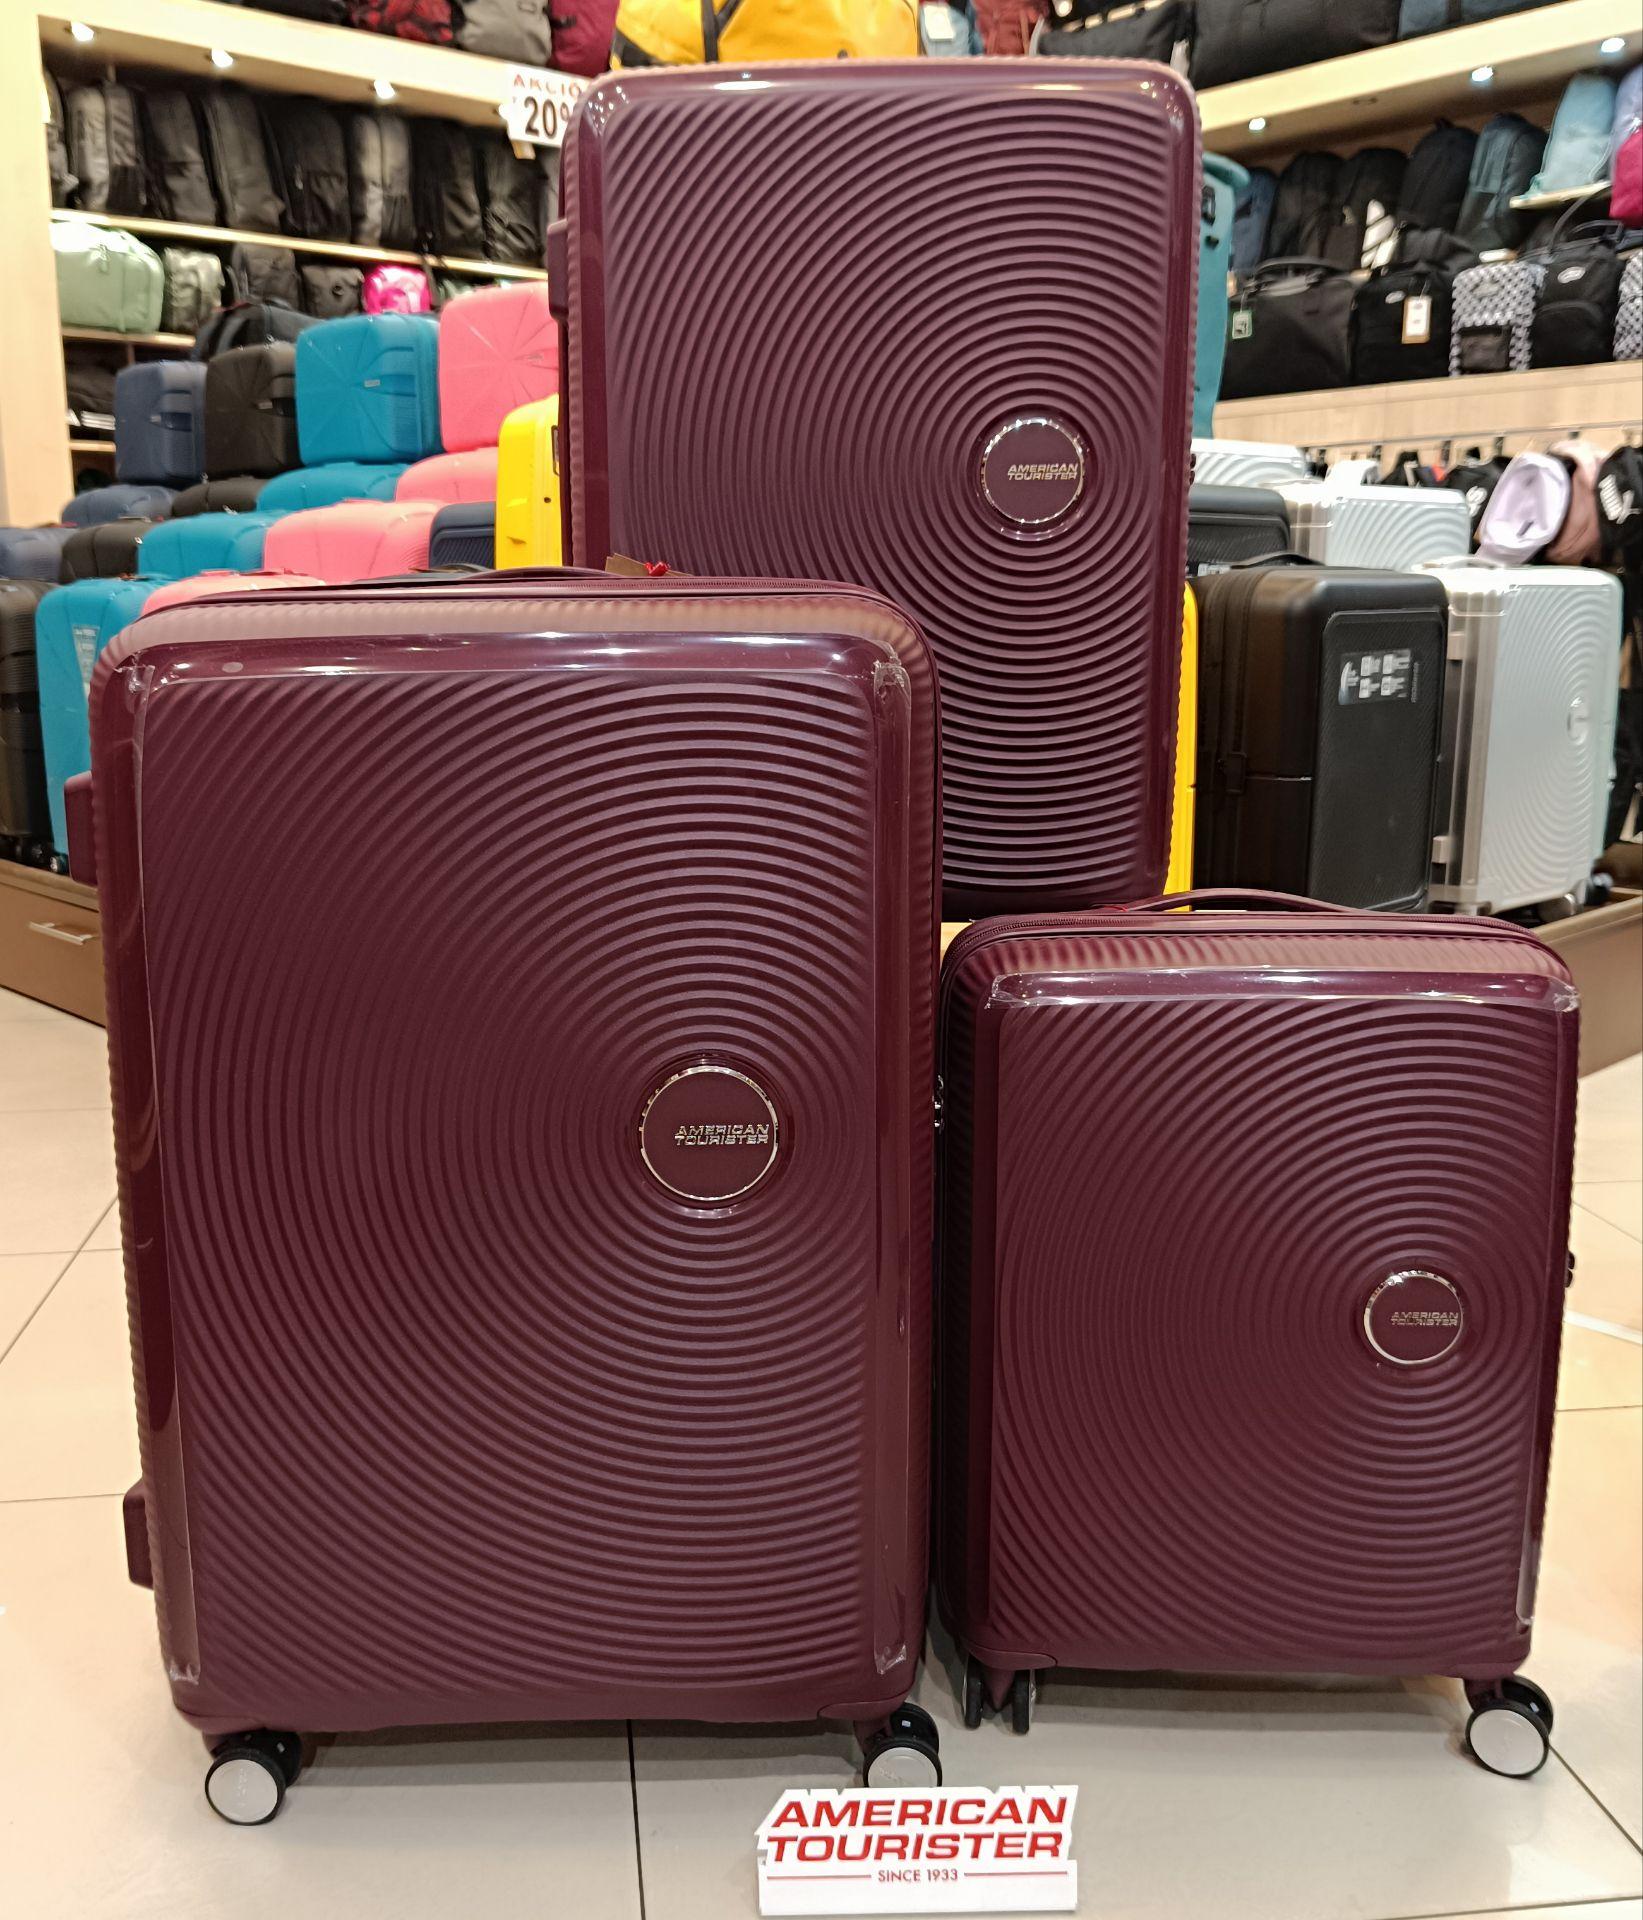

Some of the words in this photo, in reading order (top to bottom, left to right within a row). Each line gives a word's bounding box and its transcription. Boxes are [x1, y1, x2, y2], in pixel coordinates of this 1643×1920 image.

[1008, 463, 1078, 473] AMERICAN
[1007, 472, 1077, 481] TOURISTER
[675, 1124, 769, 1135] AMERICAN
[674, 1135, 769, 1146] TOURISTER
[1391, 1311, 1459, 1319] AMERICAN
[1390, 1318, 1458, 1326] TOURISTER
[771, 1796, 1068, 1828] AMERICAN
[767, 1830, 1063, 1862] TOURISTER
[877, 1869, 921, 1883] SINCE
[927, 1868, 959, 1881] 1933
